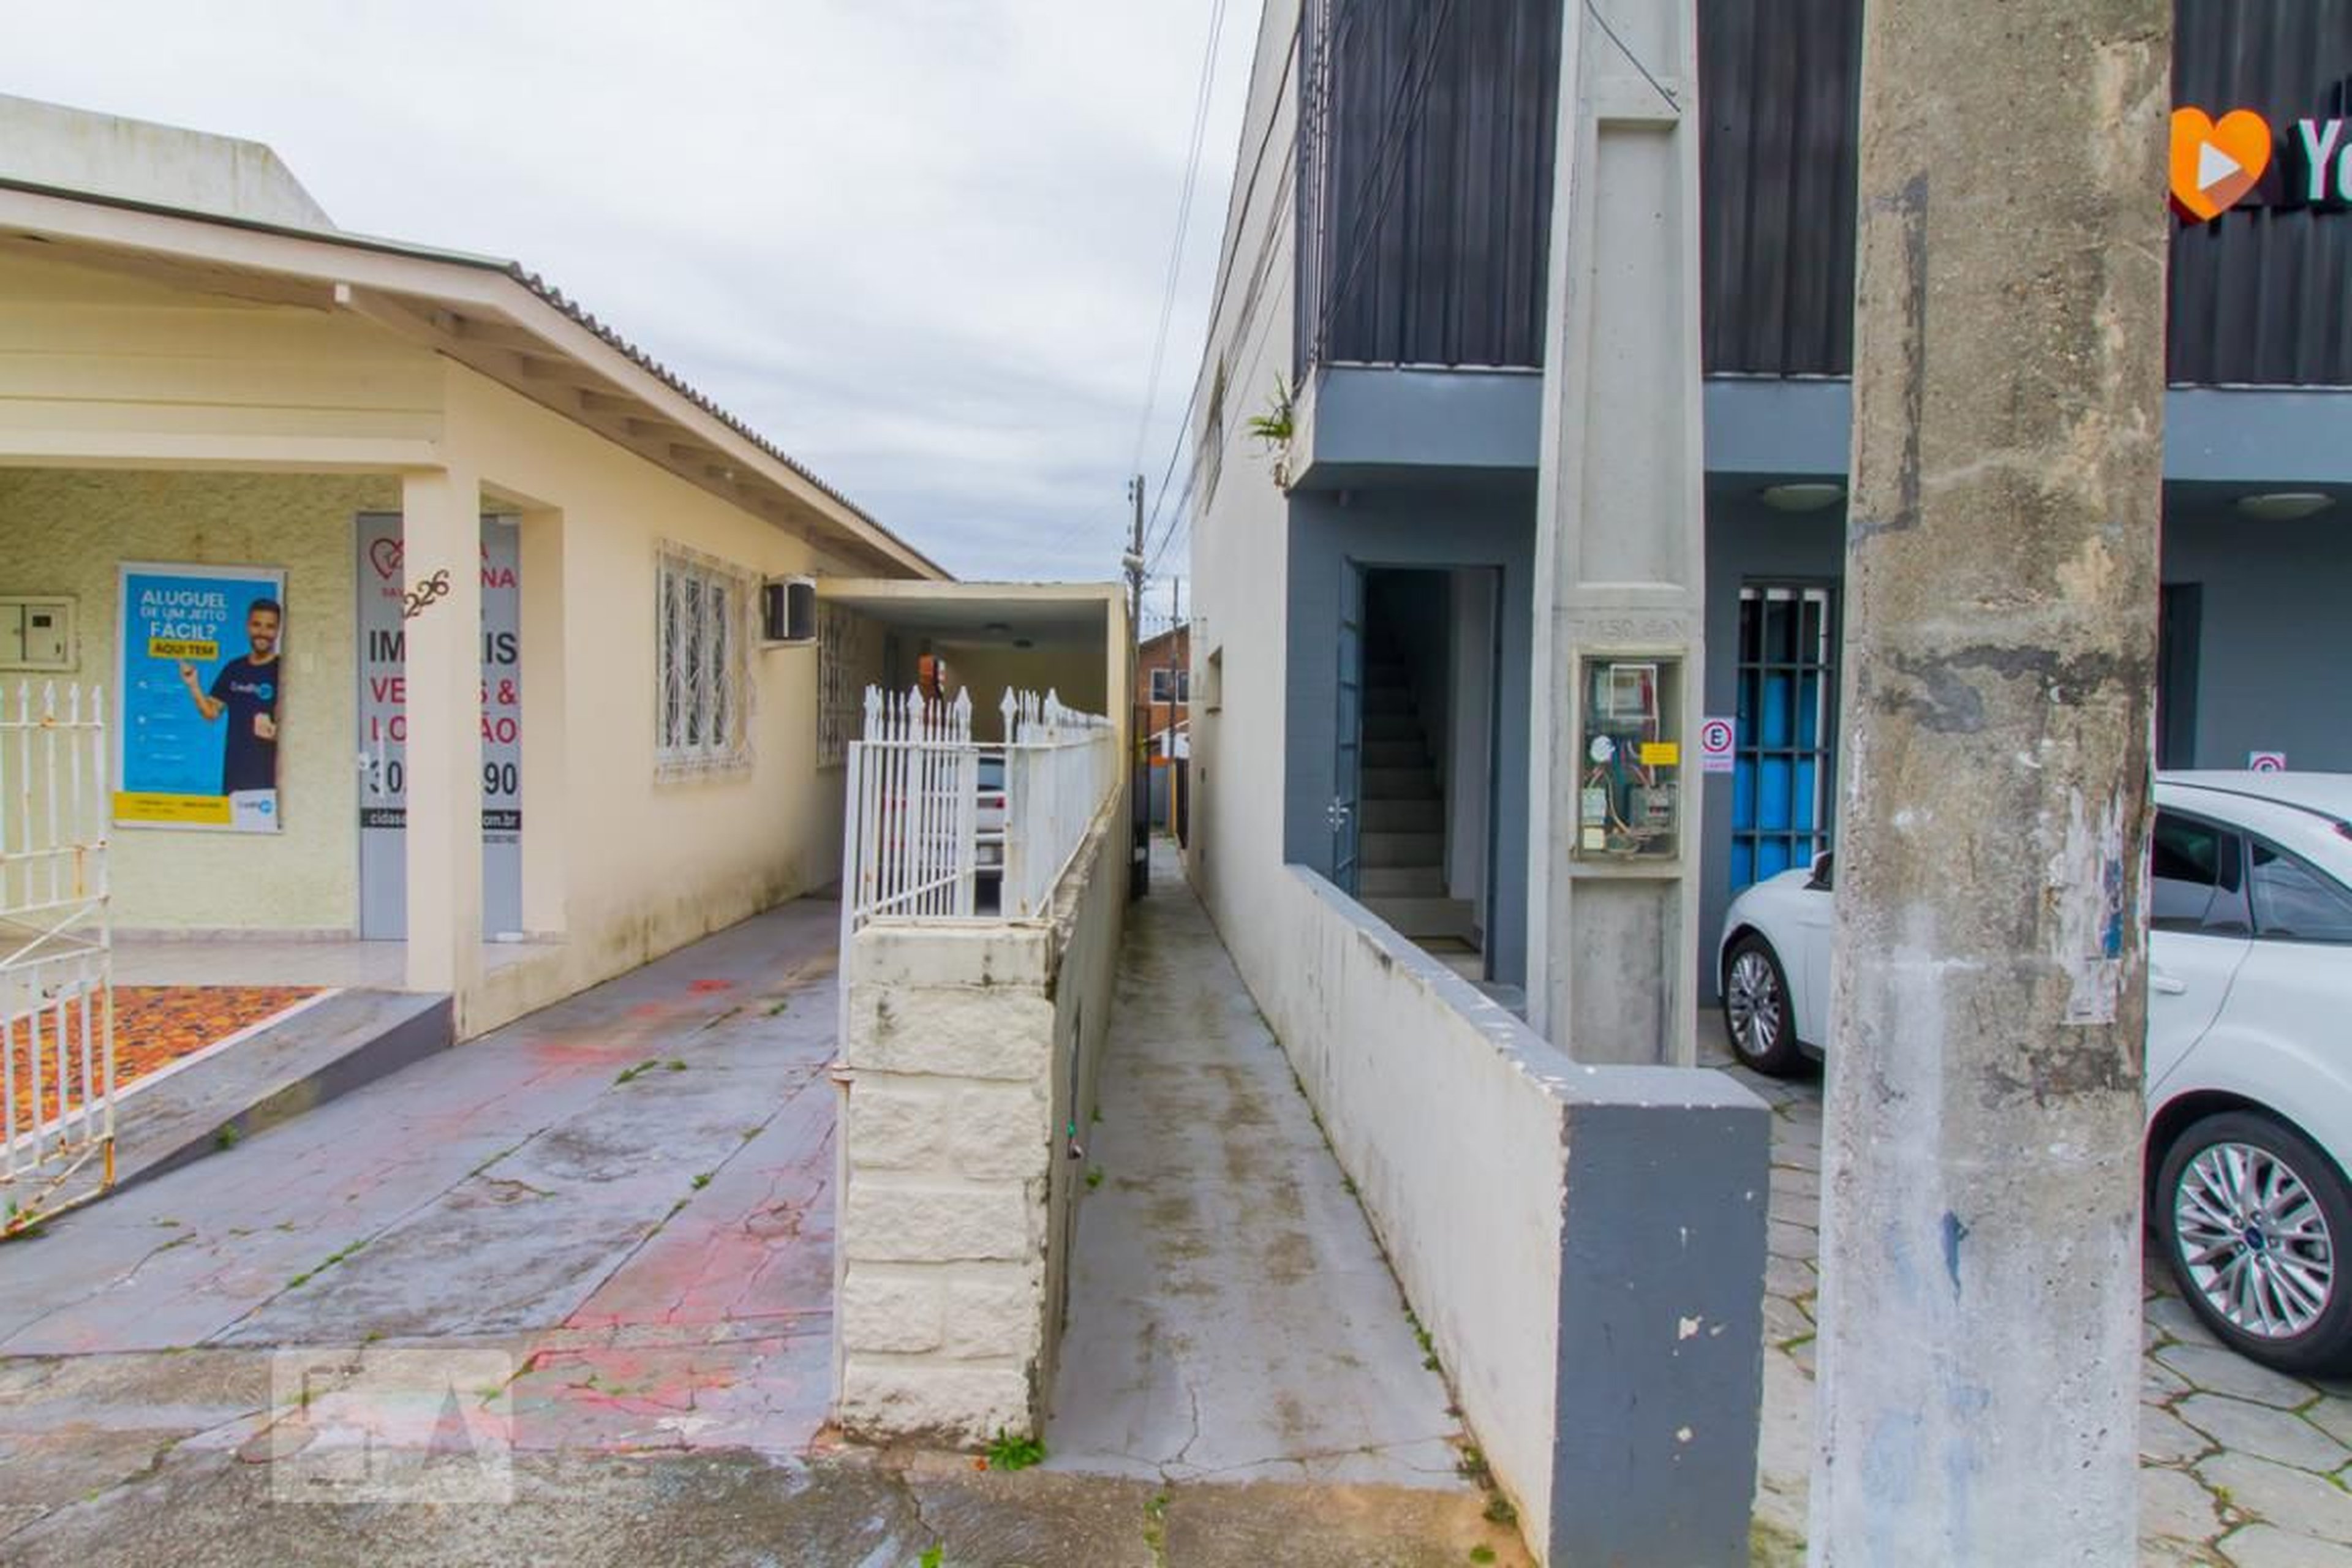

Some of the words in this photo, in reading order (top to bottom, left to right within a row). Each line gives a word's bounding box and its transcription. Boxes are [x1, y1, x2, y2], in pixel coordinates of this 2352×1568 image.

[141, 589, 227, 607] ALUGUEL
[402, 569, 450, 620] 226
[140, 606, 156, 618] DE
[189, 609, 227, 622] JEITO
[154, 643, 184, 655] AQUI
[187, 644, 215, 656] TEM
[370, 630, 518, 665] IMIS
[1710, 728, 1723, 746] E
